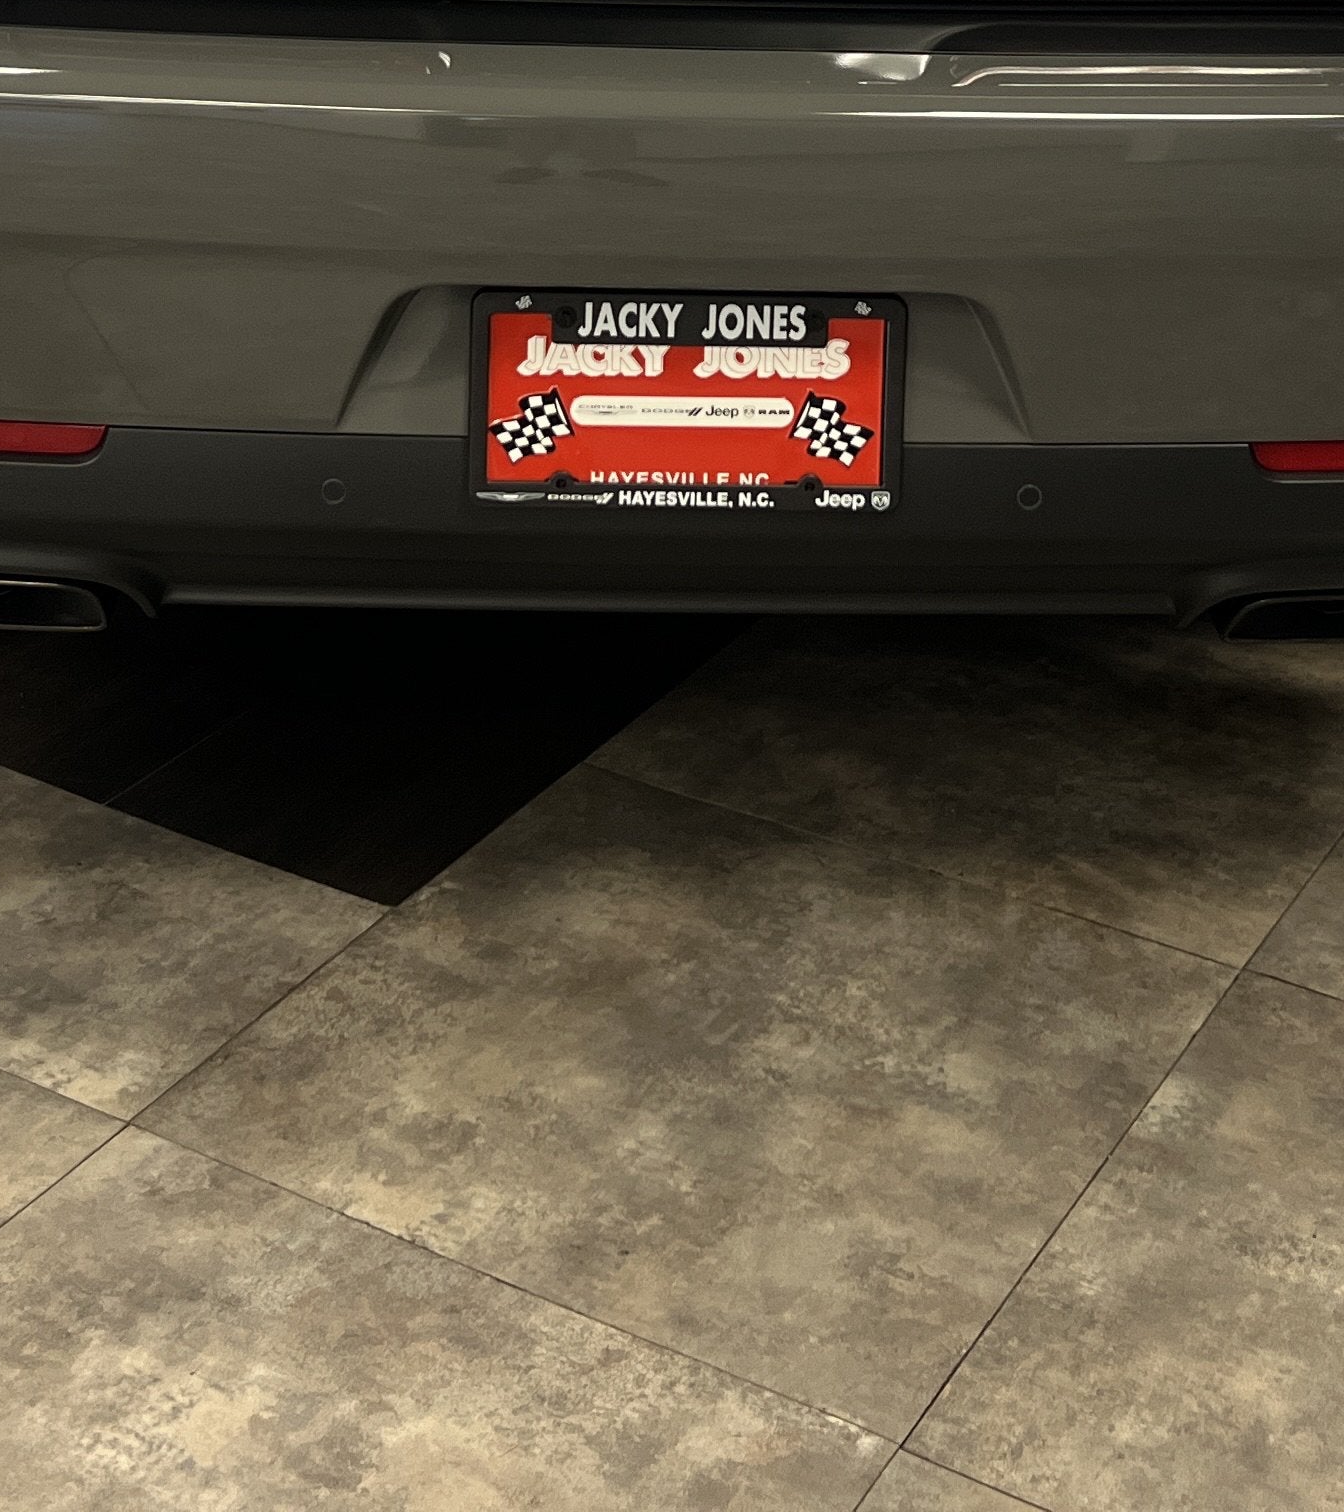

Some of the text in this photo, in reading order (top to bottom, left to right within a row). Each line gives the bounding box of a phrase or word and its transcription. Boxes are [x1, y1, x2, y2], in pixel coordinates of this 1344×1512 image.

[578, 301, 808, 341] JACKY JONES
[516, 335, 852, 381] JACKY JONES
[706, 404, 739, 418] Jeep
[618, 490, 734, 508] HAYESVILLE,
[738, 491, 775, 508] N.C.
[815, 489, 866, 510] Jeep
